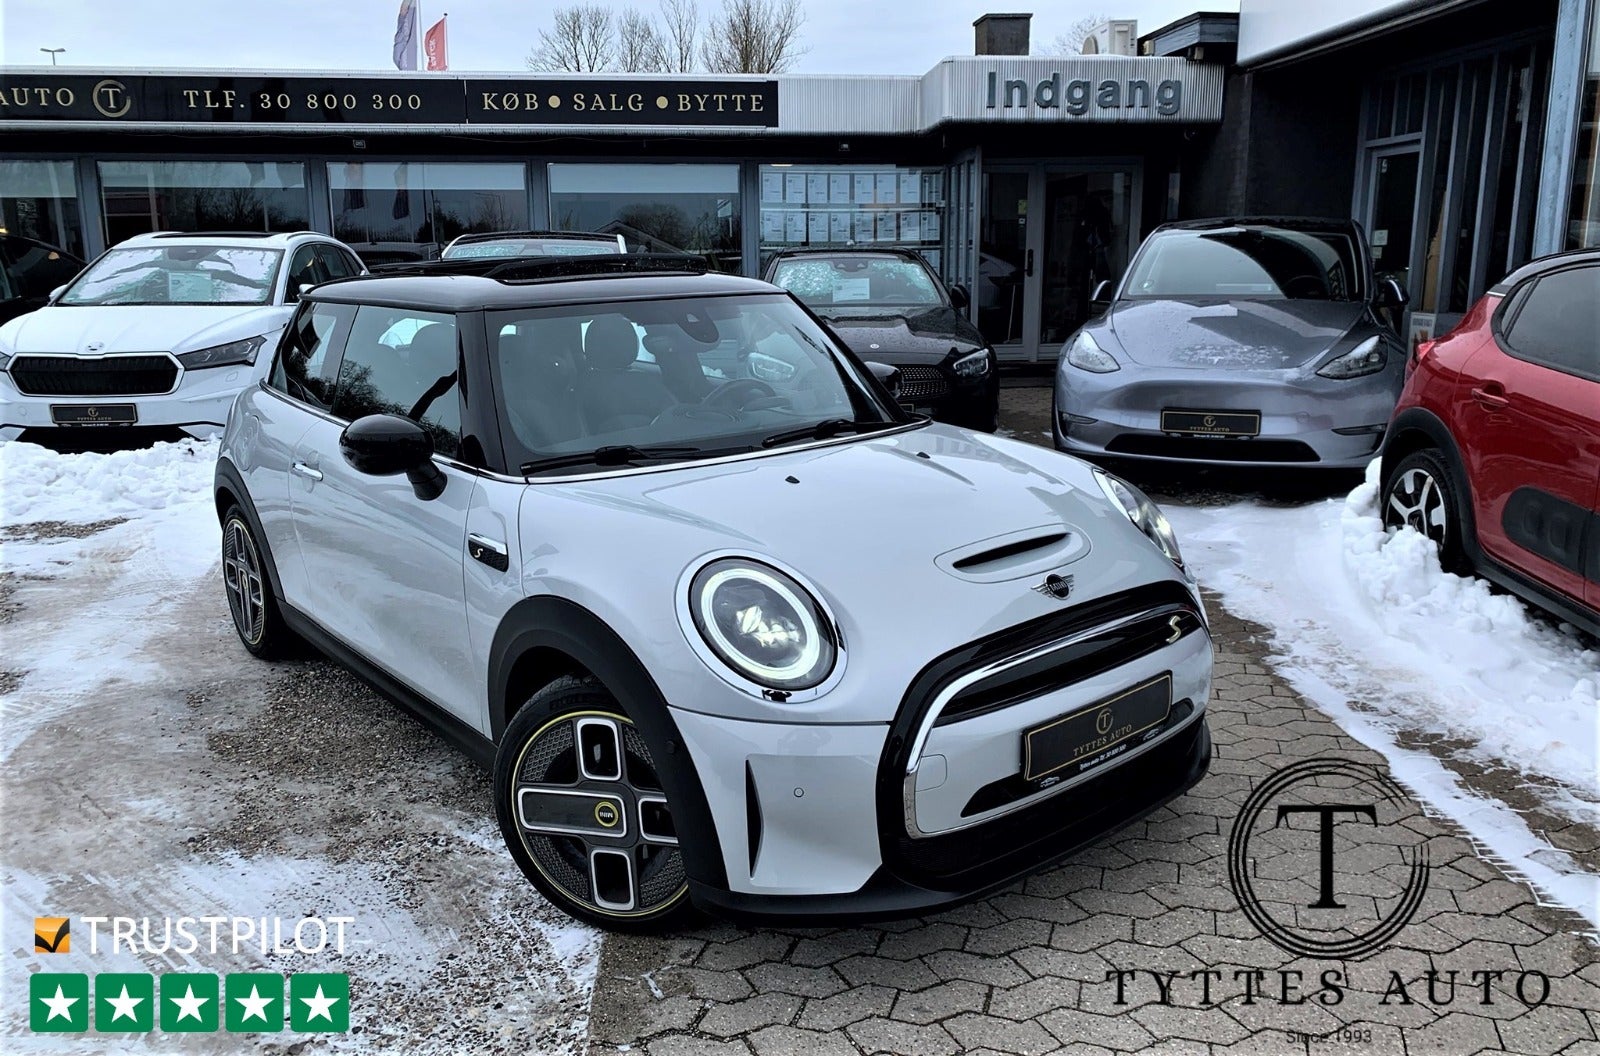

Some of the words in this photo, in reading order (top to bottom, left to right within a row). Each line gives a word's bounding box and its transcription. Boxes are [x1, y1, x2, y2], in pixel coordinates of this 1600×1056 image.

[183, 89, 246, 109] TLF.
[260, 93, 291, 110] 30
[306, 93, 357, 110] 800
[372, 94, 422, 111] 300
[482, 92, 540, 111] KØB
[573, 93, 644, 112] SALG
[677, 94, 765, 113] BYTTE
[986, 71, 1182, 116] Indgang
[1166, 615, 1181, 644] S
[1073, 736, 1107, 756] TYTTES
[1110, 724, 1132, 741] AUTO
